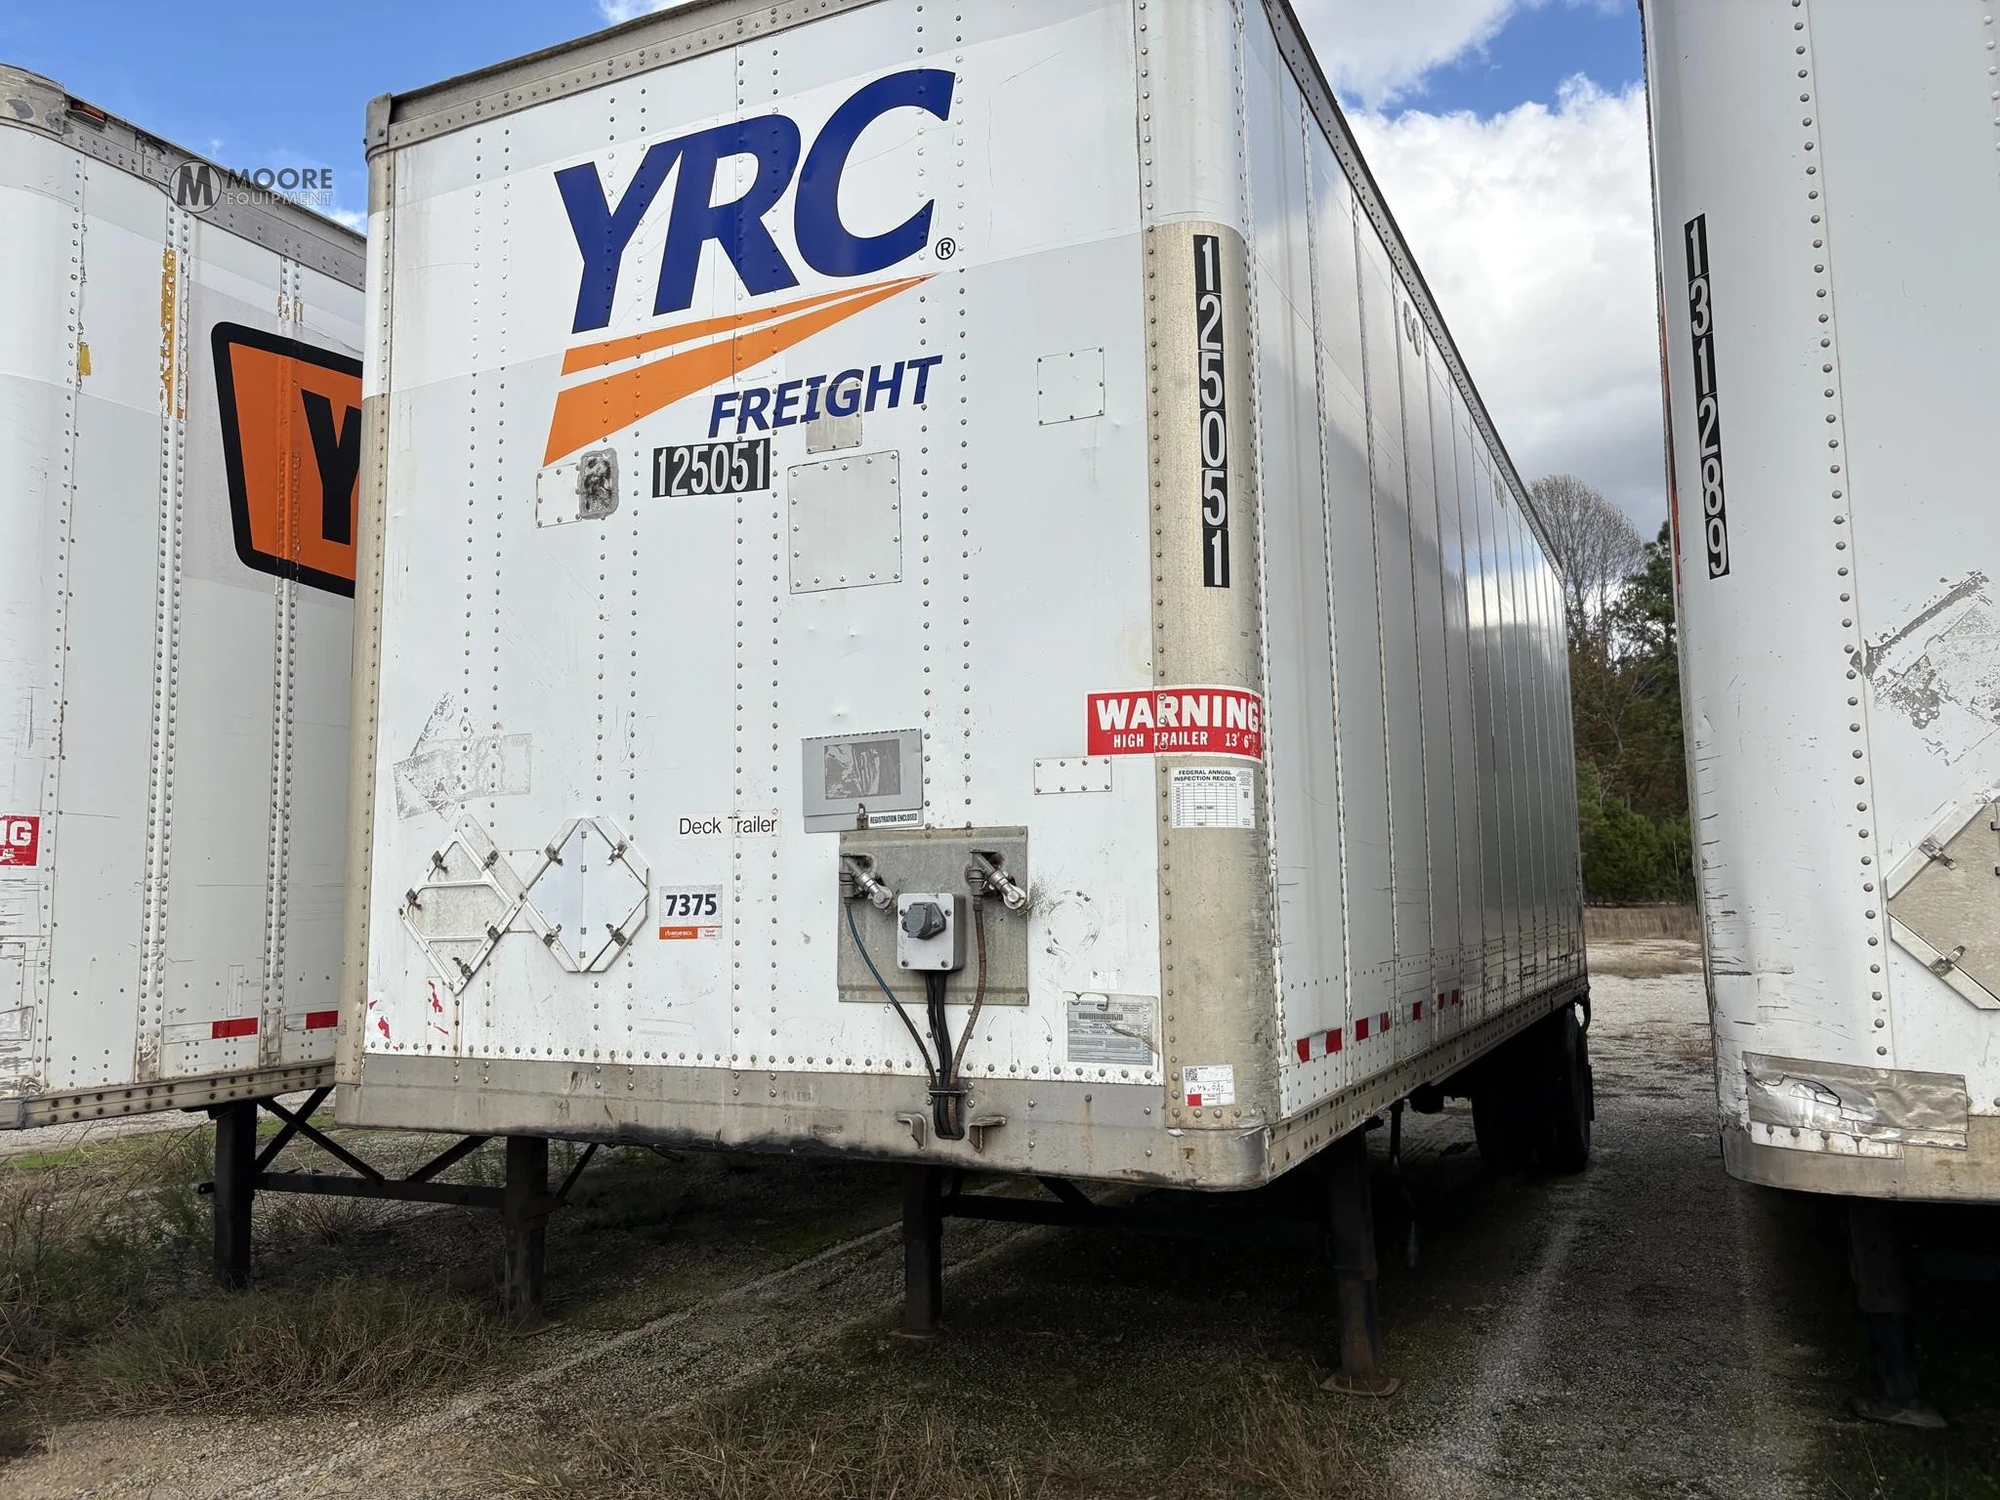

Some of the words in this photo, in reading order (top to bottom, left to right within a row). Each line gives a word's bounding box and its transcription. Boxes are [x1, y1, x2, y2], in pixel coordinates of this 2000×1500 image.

[708, 355, 943, 438] FREIGHT
[1200, 237, 1225, 586] 125051
[1688, 219, 1728, 578] 131289
[658, 440, 764, 496] 125051
[1096, 695, 1259, 733] WARNING
[1113, 733, 1144, 748] HIGH
[1154, 731, 1208, 749] TRAILER
[679, 816, 722, 835] Deck
[727, 815, 778, 834] Trailer
[869, 815, 897, 825] REGISTRATION
[897, 812, 918, 822] ENCLOSED
[666, 893, 717, 917] 7375
